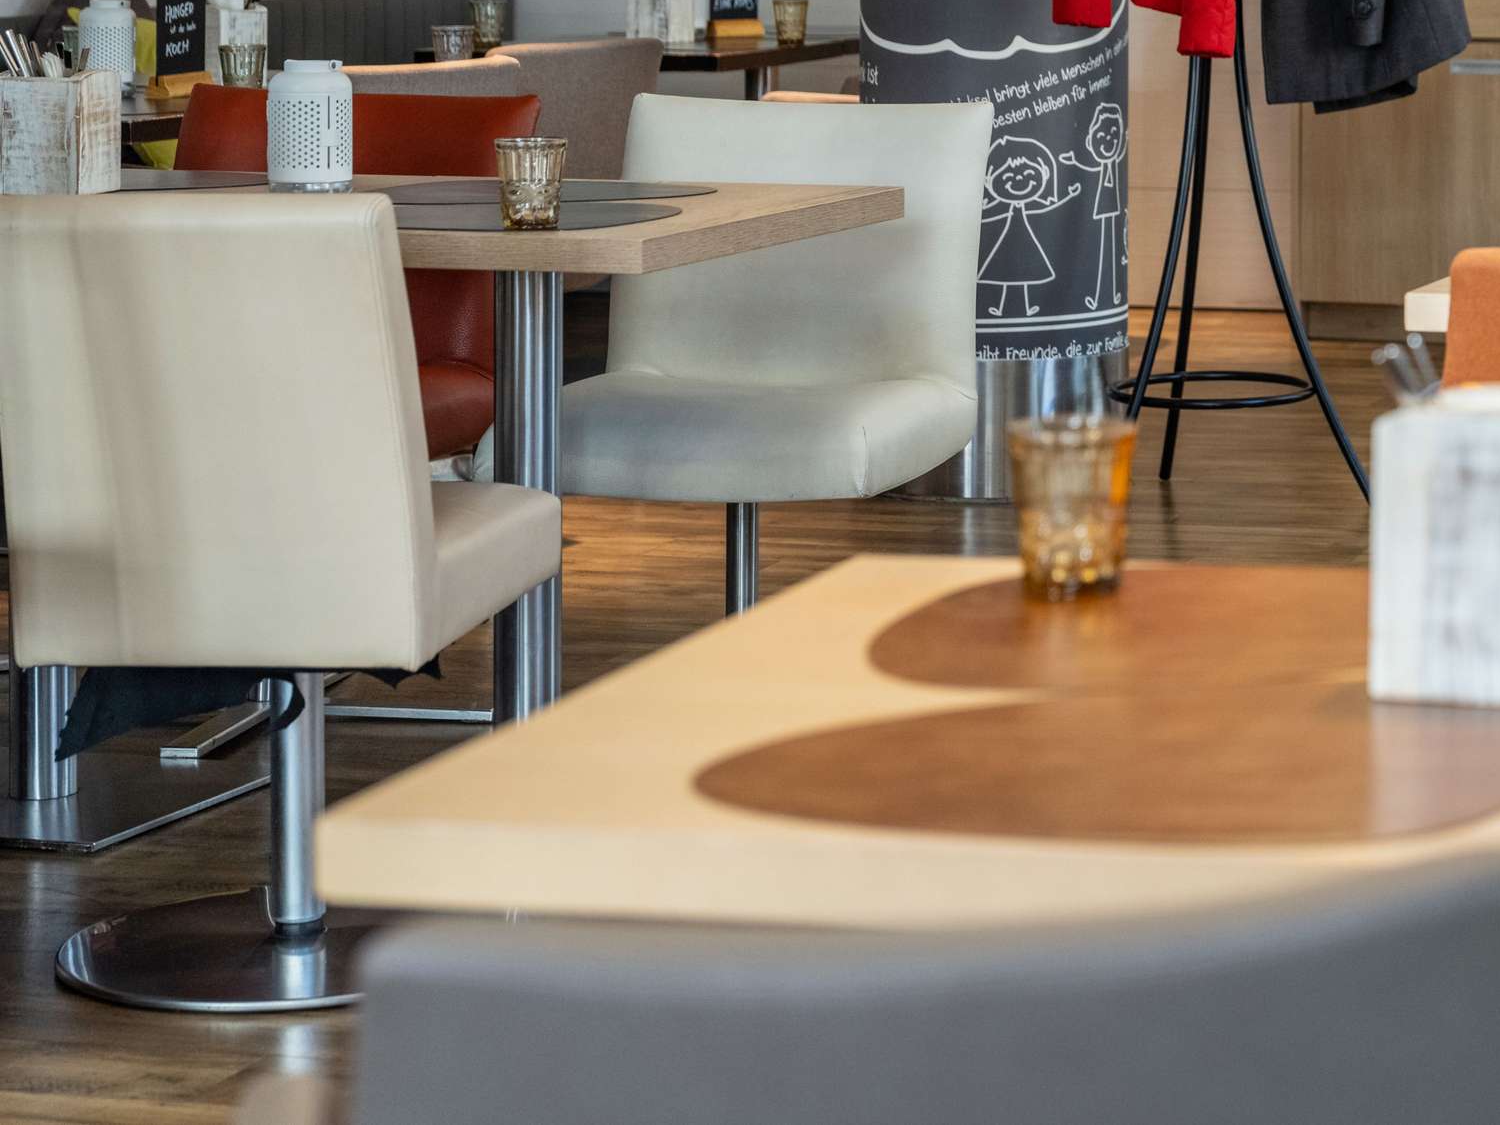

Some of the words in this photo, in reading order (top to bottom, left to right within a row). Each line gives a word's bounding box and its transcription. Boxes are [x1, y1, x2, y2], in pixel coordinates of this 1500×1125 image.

[165, 38, 190, 58] KOCH
[993, 80, 1031, 103] bringt
[1033, 71, 1060, 92] viele
[1061, 52, 1105, 82] Menschen
[1032, 93, 1071, 116] bleiben
[1071, 84, 1087, 103] für
[1006, 344, 1061, 361] Freunde,
[1065, 339, 1082, 358] die
[1086, 340, 1102, 356] zur
